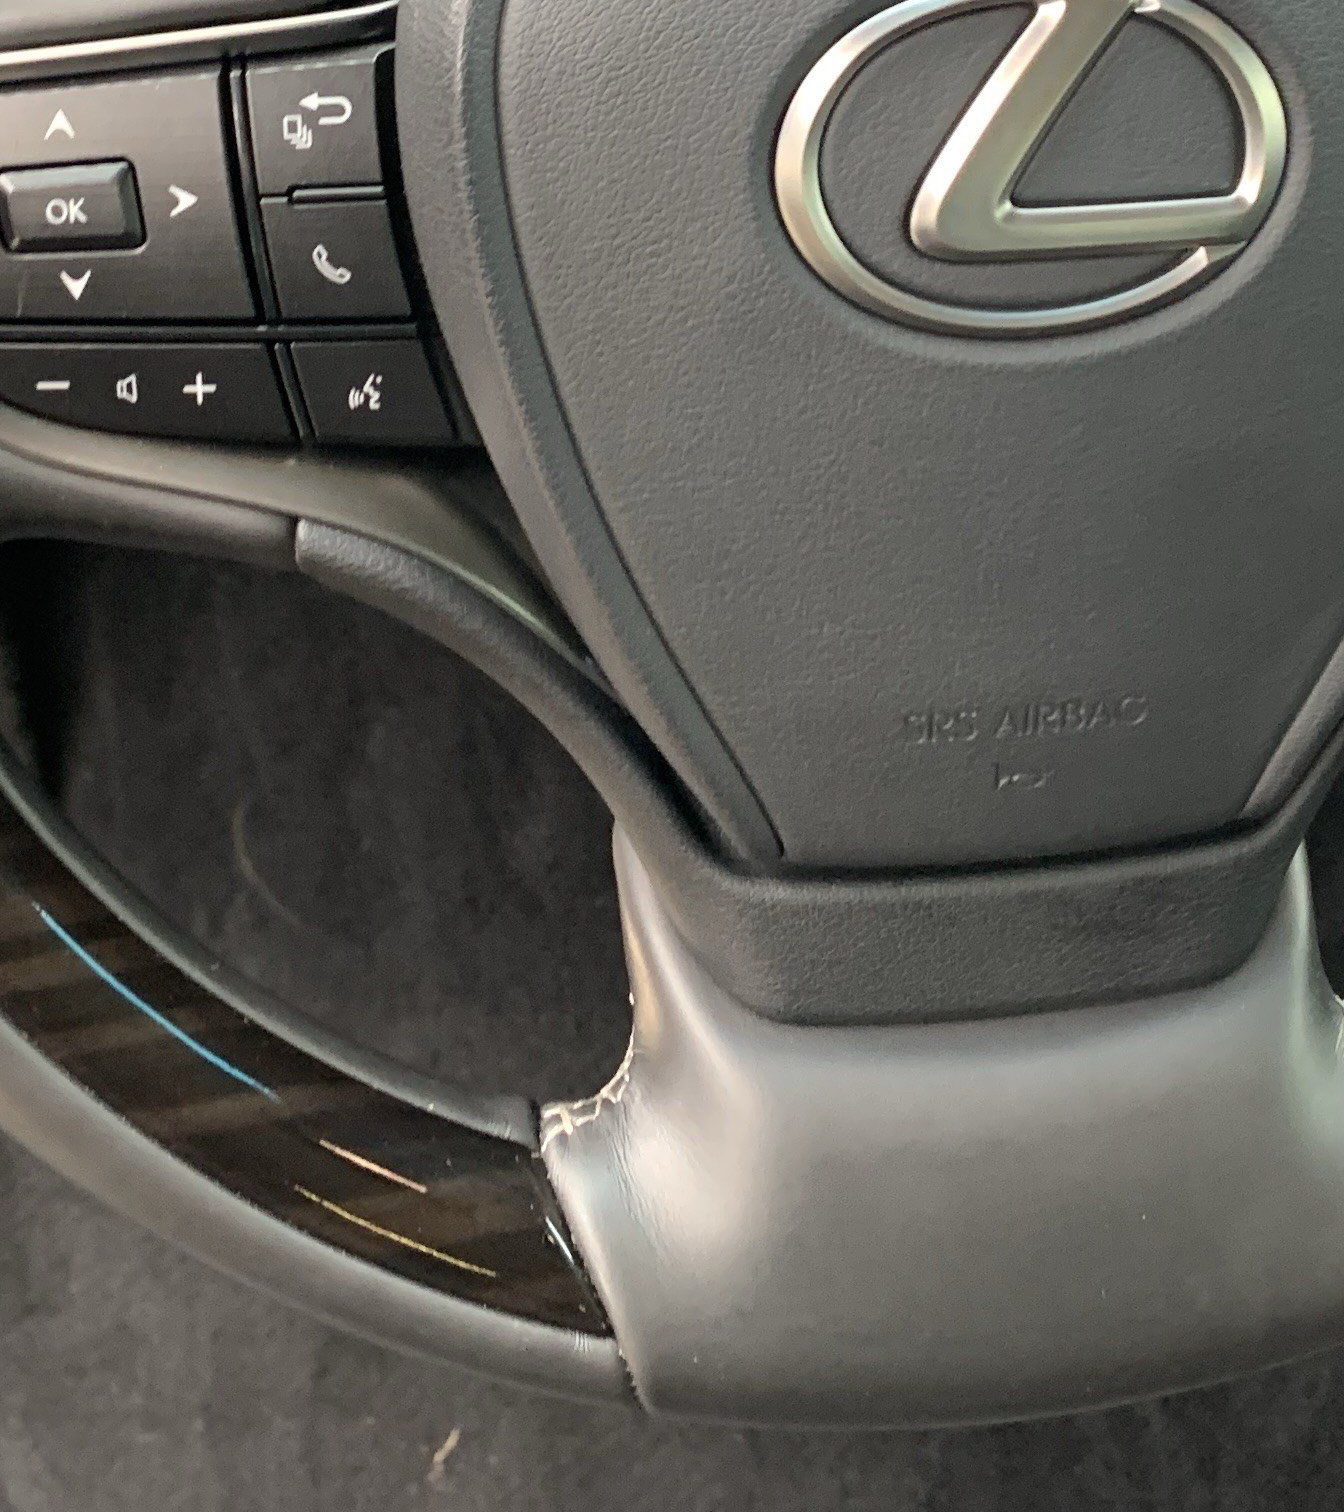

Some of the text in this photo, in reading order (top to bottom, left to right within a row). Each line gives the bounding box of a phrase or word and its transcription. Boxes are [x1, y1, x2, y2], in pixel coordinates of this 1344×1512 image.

[45, 196, 88, 226] OK
[905, 695, 1149, 744] SRS AIRBAG
